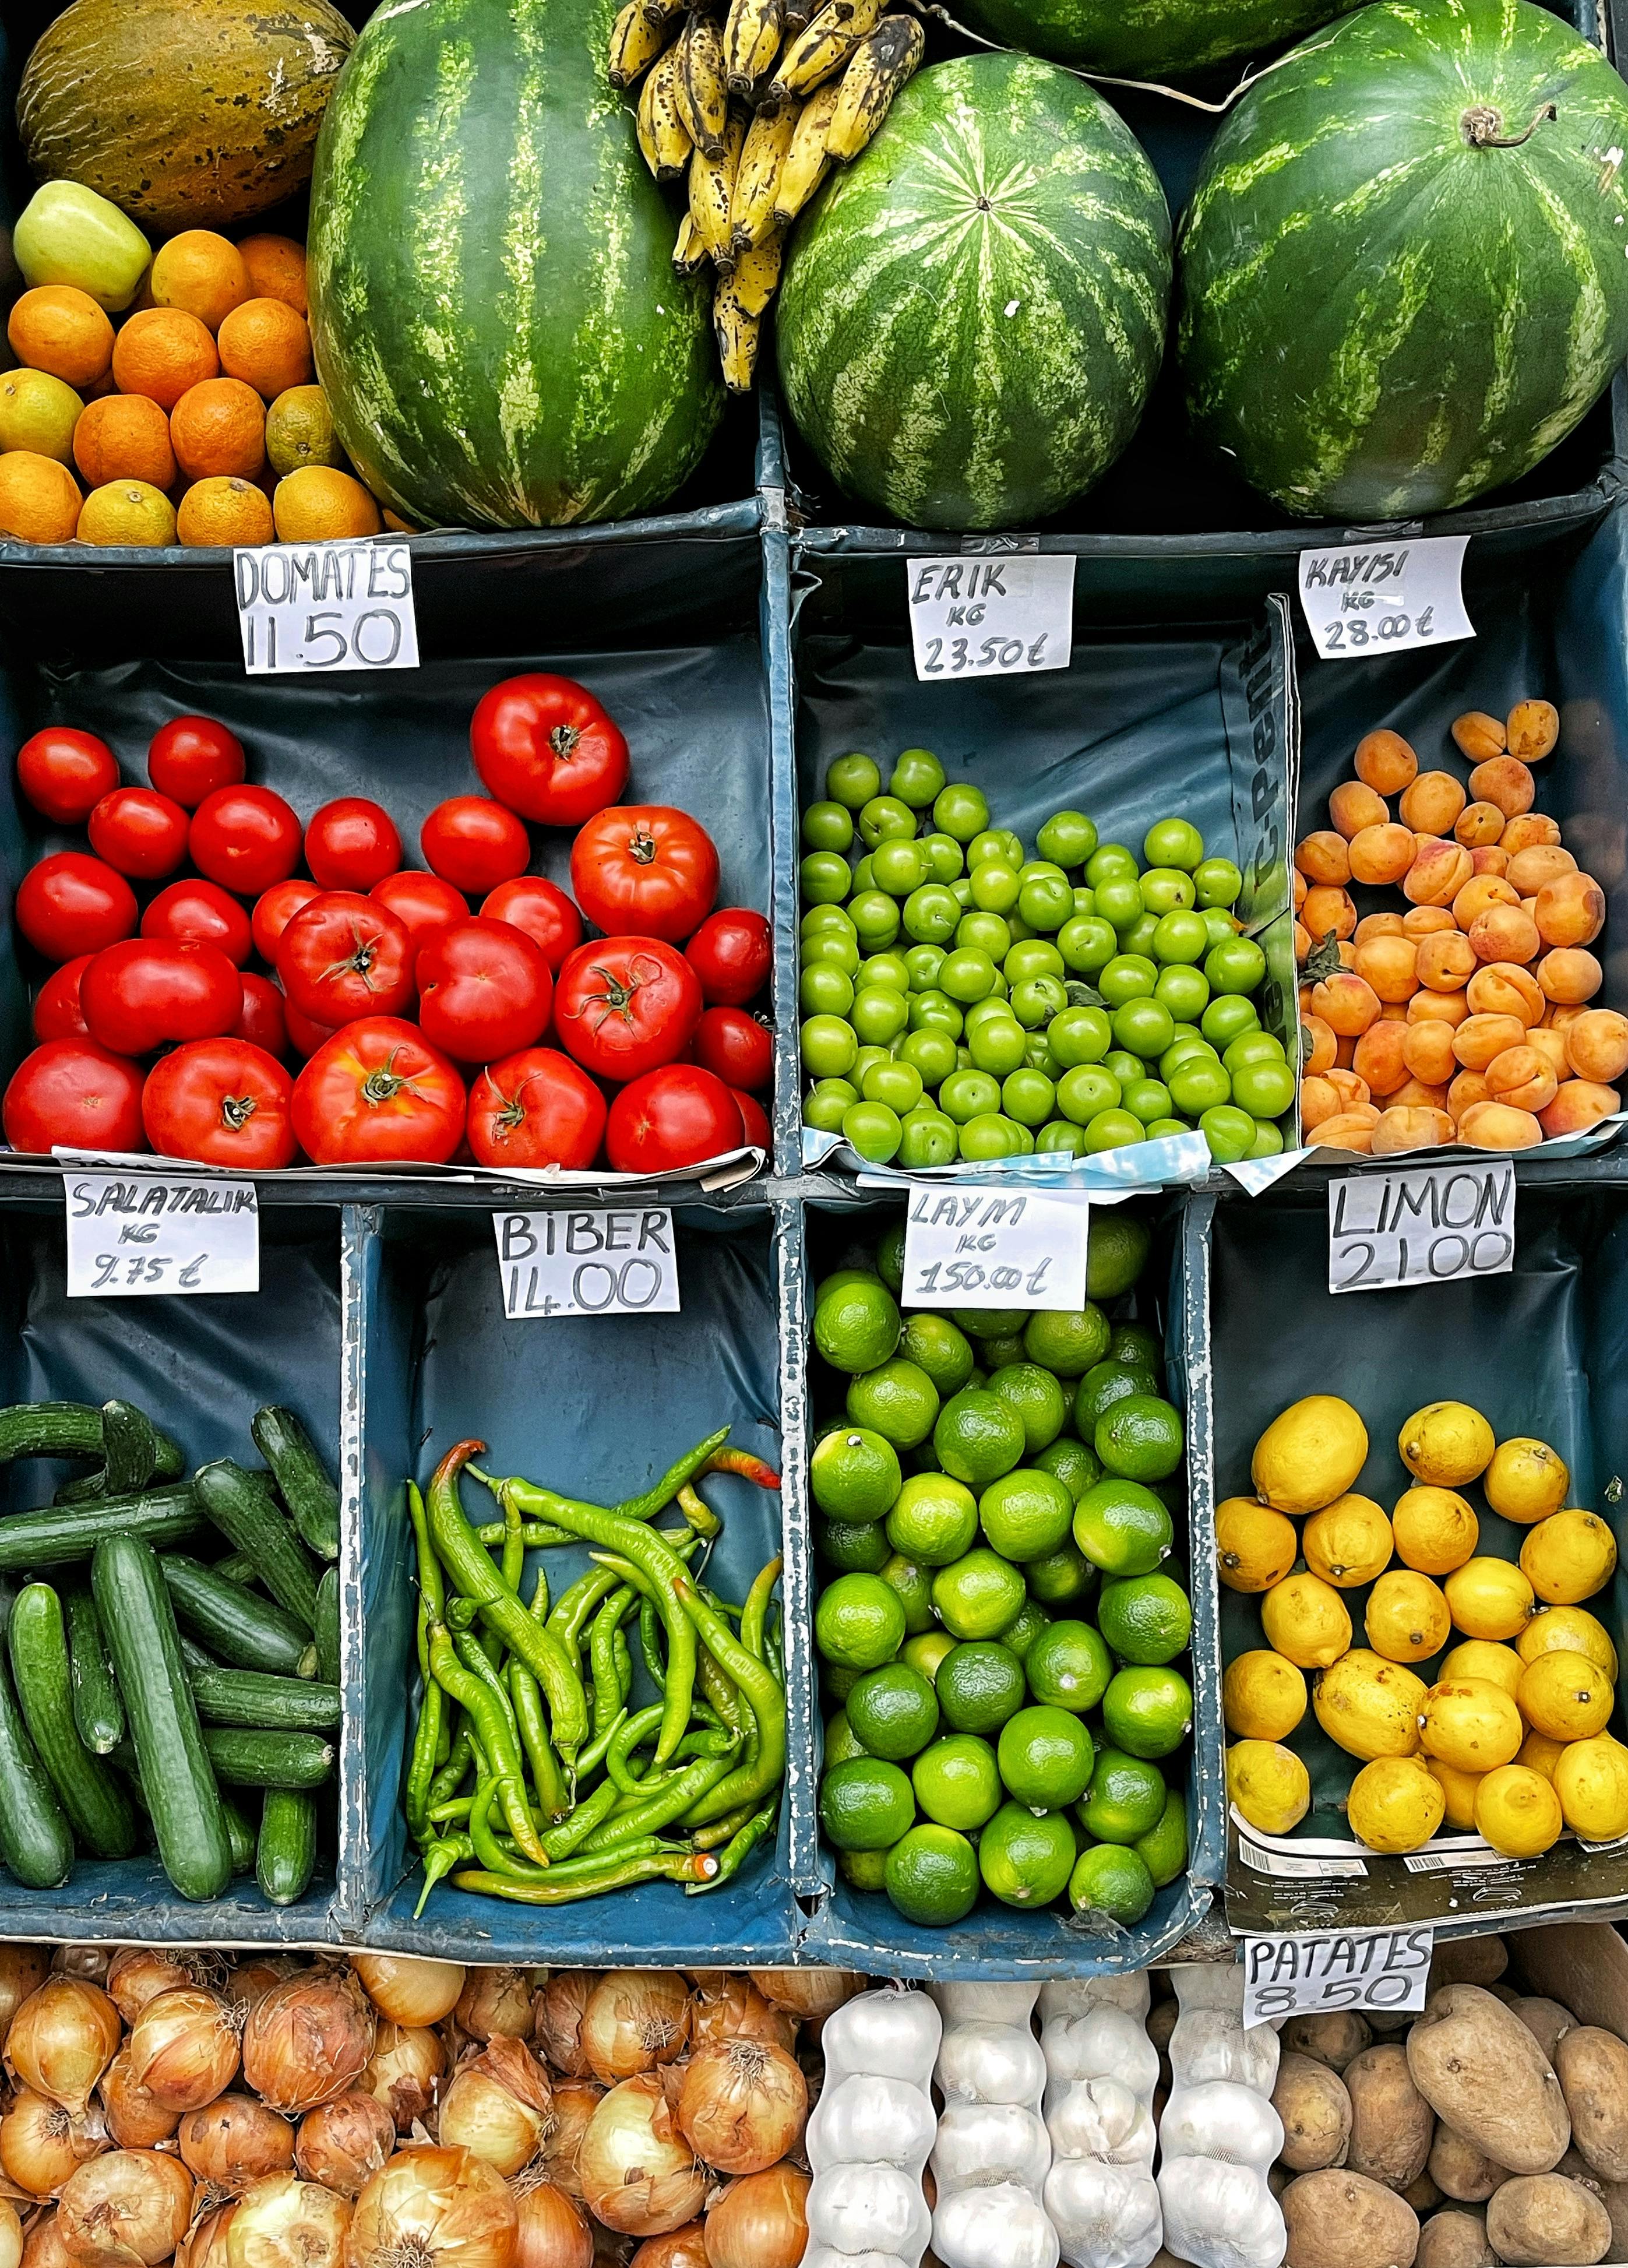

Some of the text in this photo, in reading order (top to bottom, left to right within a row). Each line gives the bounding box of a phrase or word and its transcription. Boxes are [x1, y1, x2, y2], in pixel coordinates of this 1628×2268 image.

[237, 548, 410, 611] DOMATES
[911, 564, 1006, 604] ERIK
[946, 603, 986, 627] KG
[1341, 591, 1375, 612] KG
[248, 608, 401, 668] 11.50
[72, 1182, 258, 1216] SALATALIK
[910, 1193, 1027, 1227] LAYM
[118, 1223, 160, 1244] KG
[955, 1234, 996, 1254] KG
[1335, 1231, 1512, 1290] 21.00
[509, 1258, 662, 1315] 14.00
[1250, 1929, 1432, 1984] PATATES
[1255, 1975, 1412, 2017] 8.50
